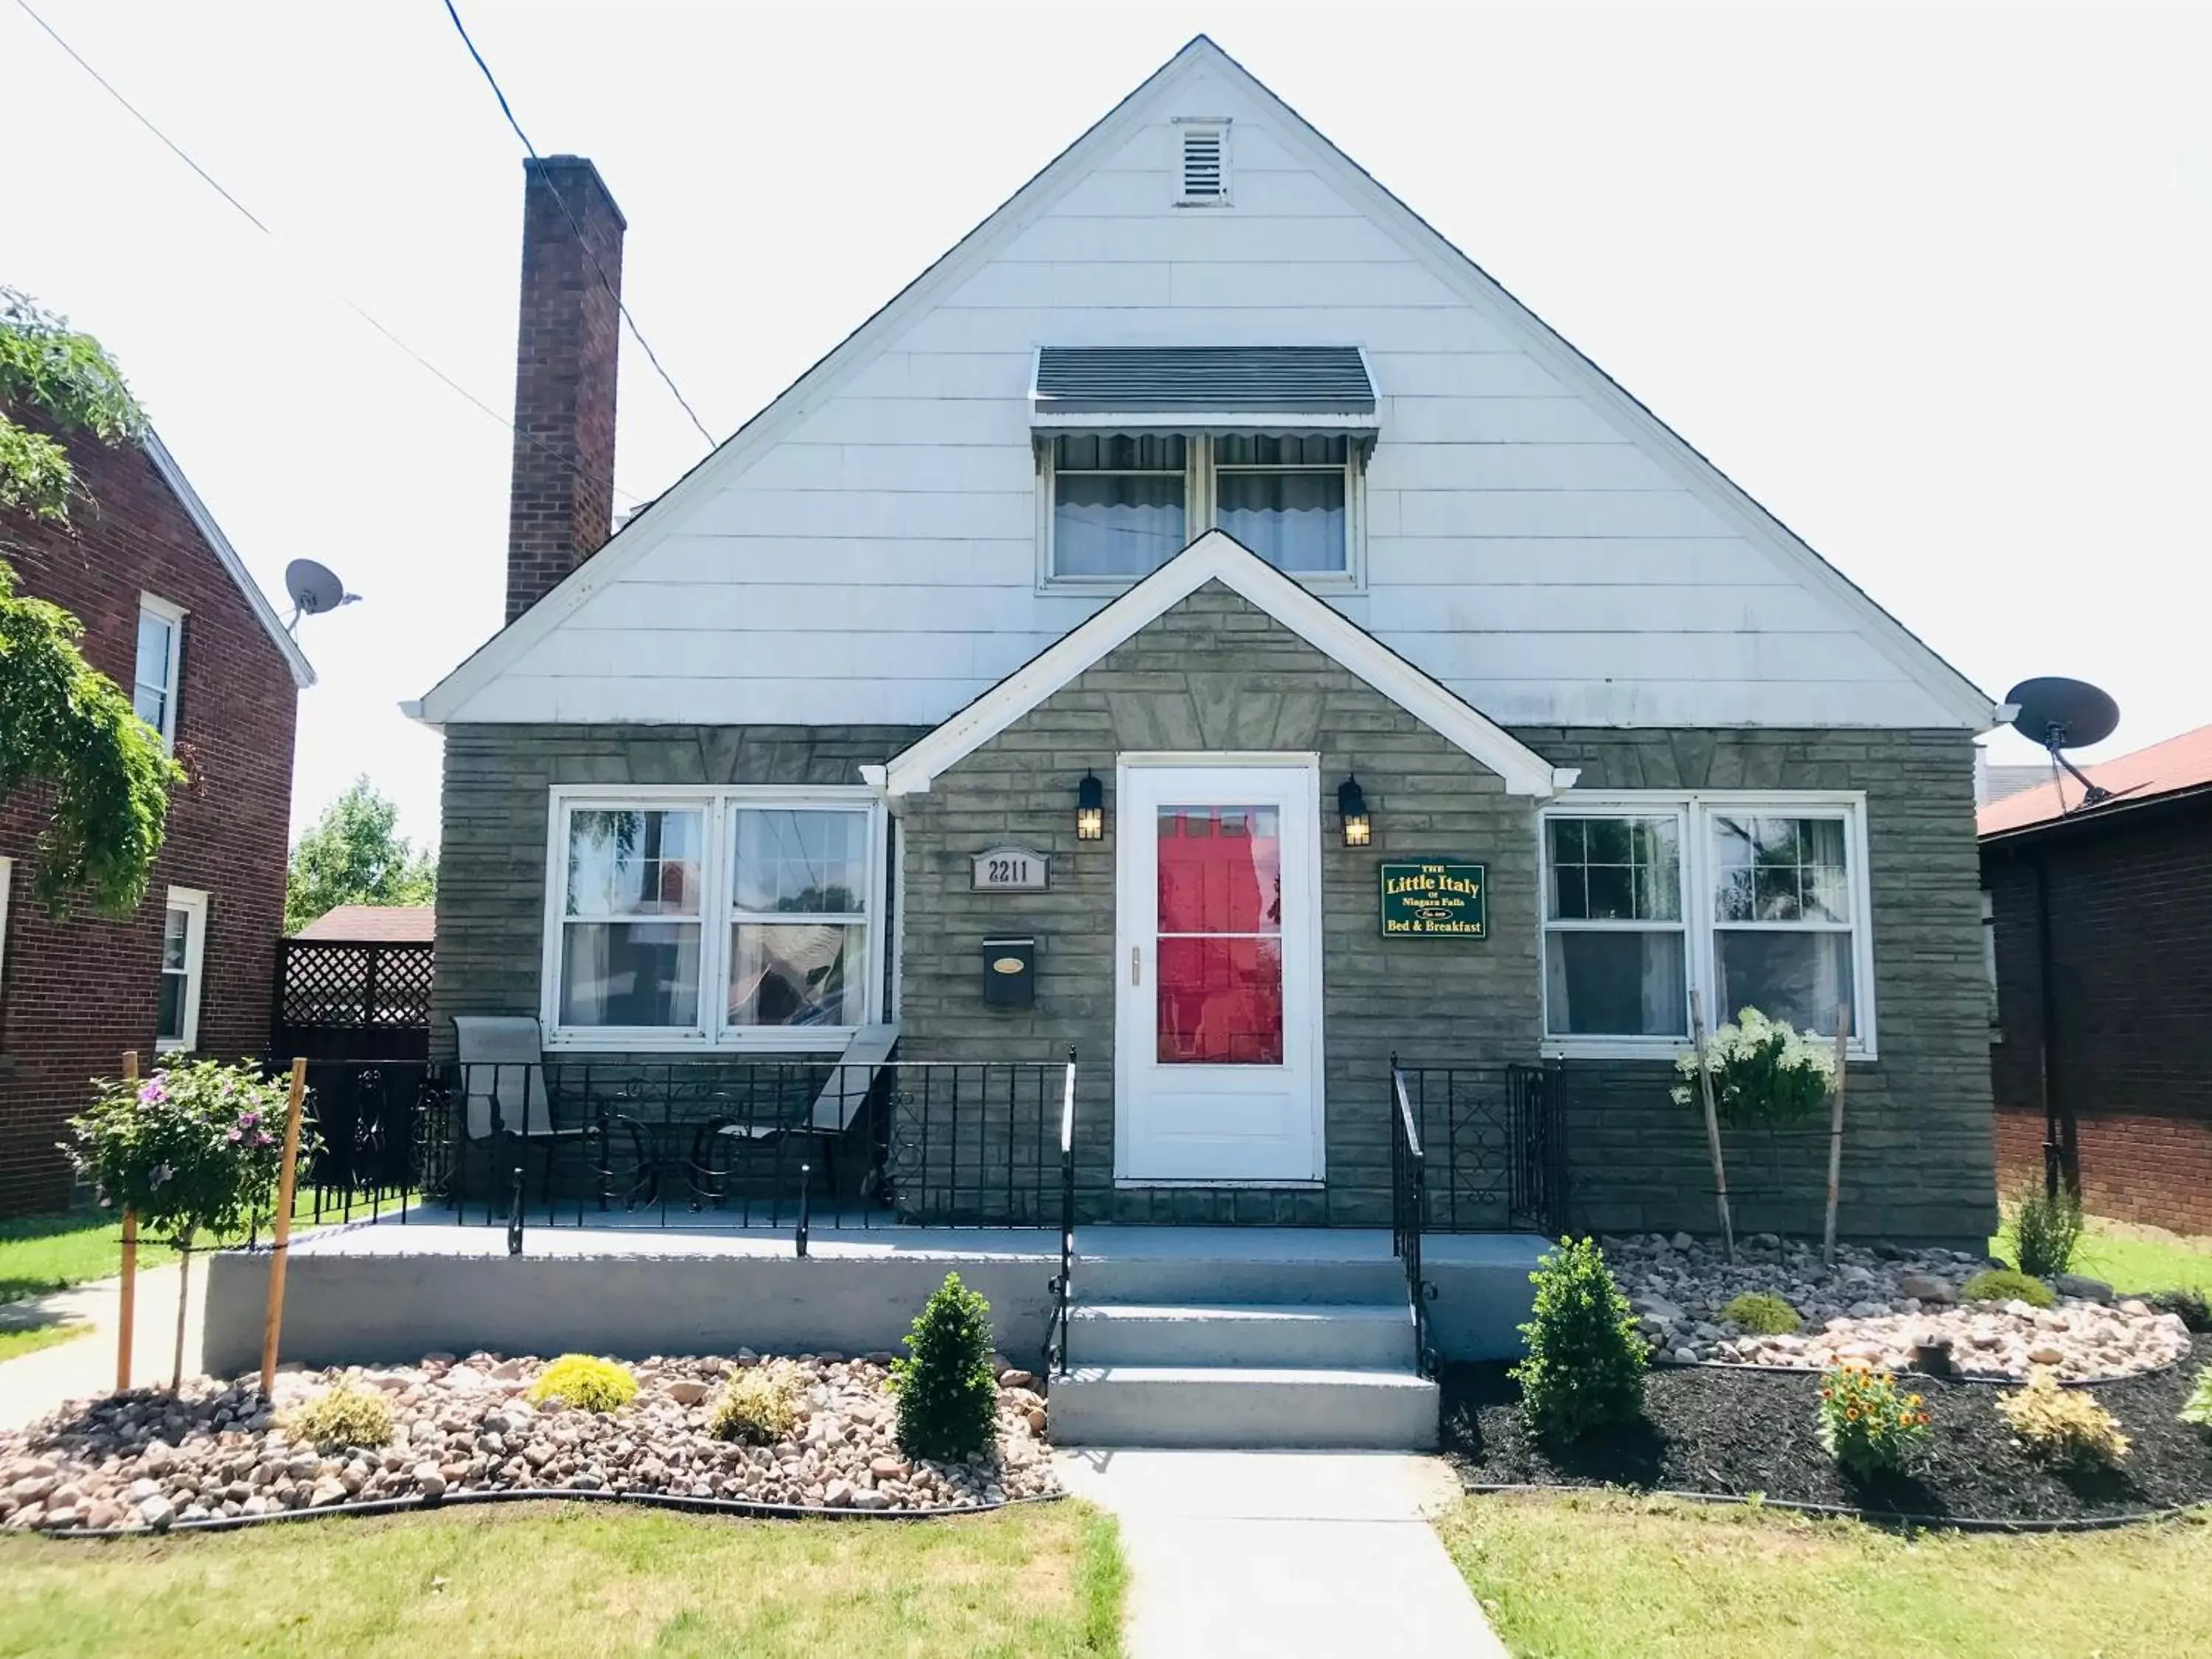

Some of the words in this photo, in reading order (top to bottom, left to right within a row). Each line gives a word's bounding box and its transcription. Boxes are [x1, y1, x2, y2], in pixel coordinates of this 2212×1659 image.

[990, 860, 1027, 882] 2211
[1387, 874, 1435, 894] Little
[1438, 875, 1479, 898] Italy
[1402, 897, 1440, 908] Niagara
[1441, 898, 1465, 906] Falls
[1387, 919, 1410, 931] Bed
[1412, 920, 1422, 931] &
[1425, 919, 1481, 933] Breakfast
